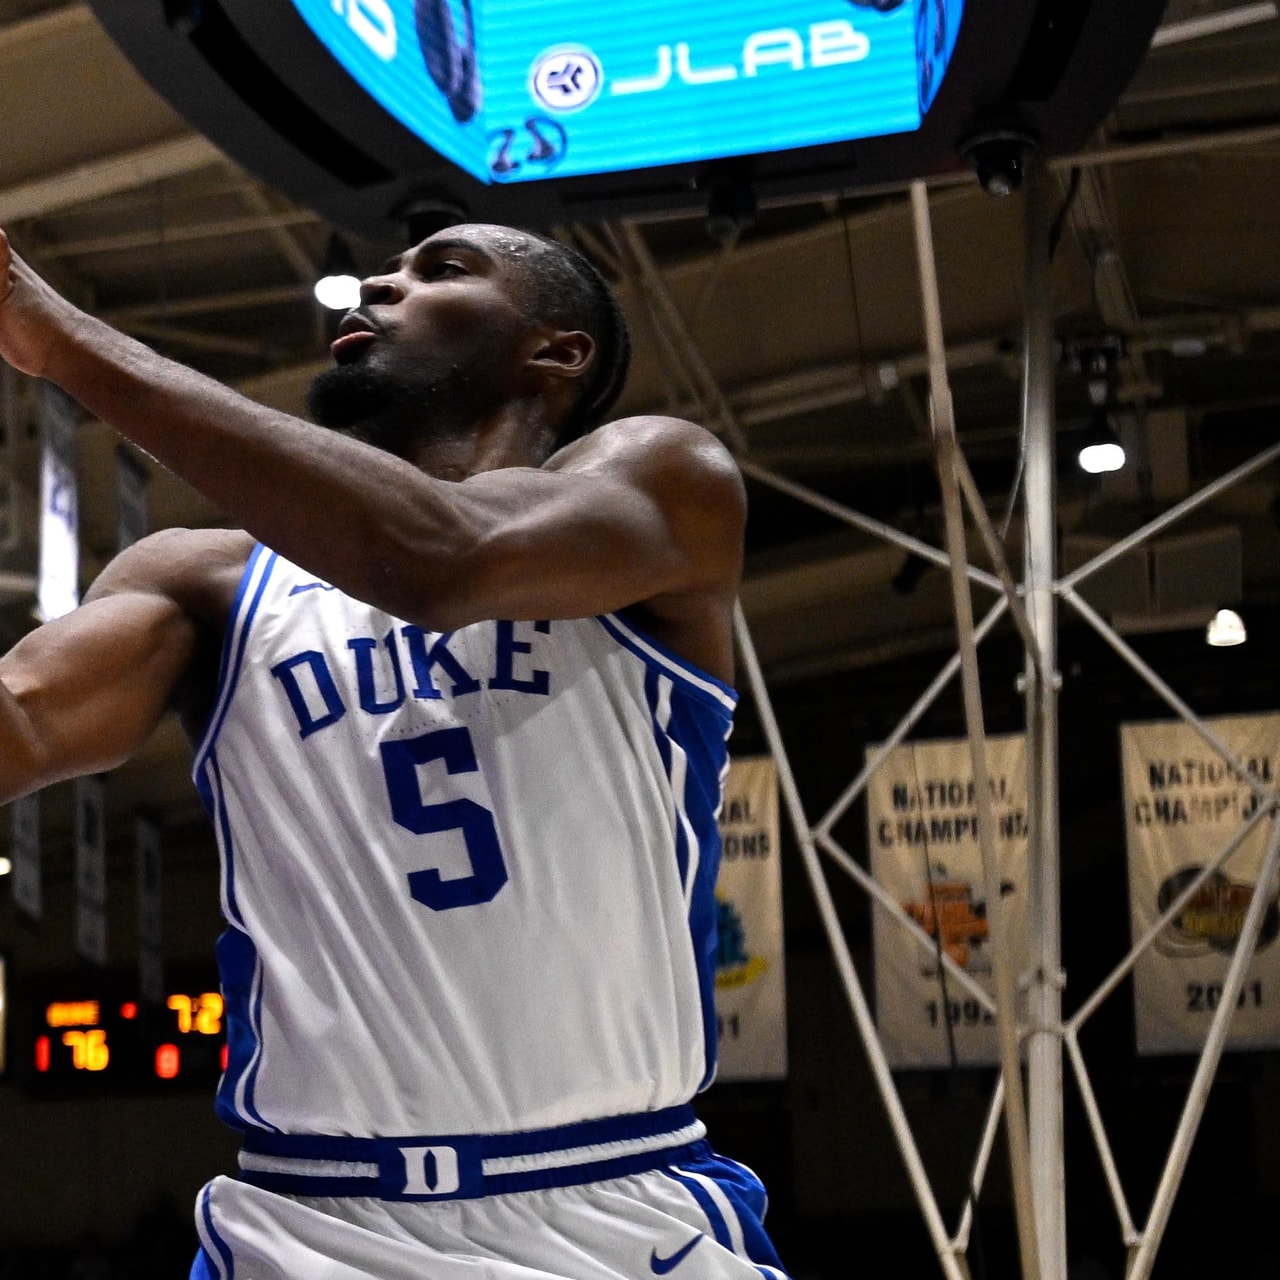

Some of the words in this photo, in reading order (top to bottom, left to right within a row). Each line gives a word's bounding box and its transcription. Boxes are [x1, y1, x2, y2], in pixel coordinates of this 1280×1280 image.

[610, 18, 871, 95] JLAB
[271, 619, 550, 740] DUKE
[379, 726, 508, 912] 5
[1186, 977, 1262, 1013] 201
